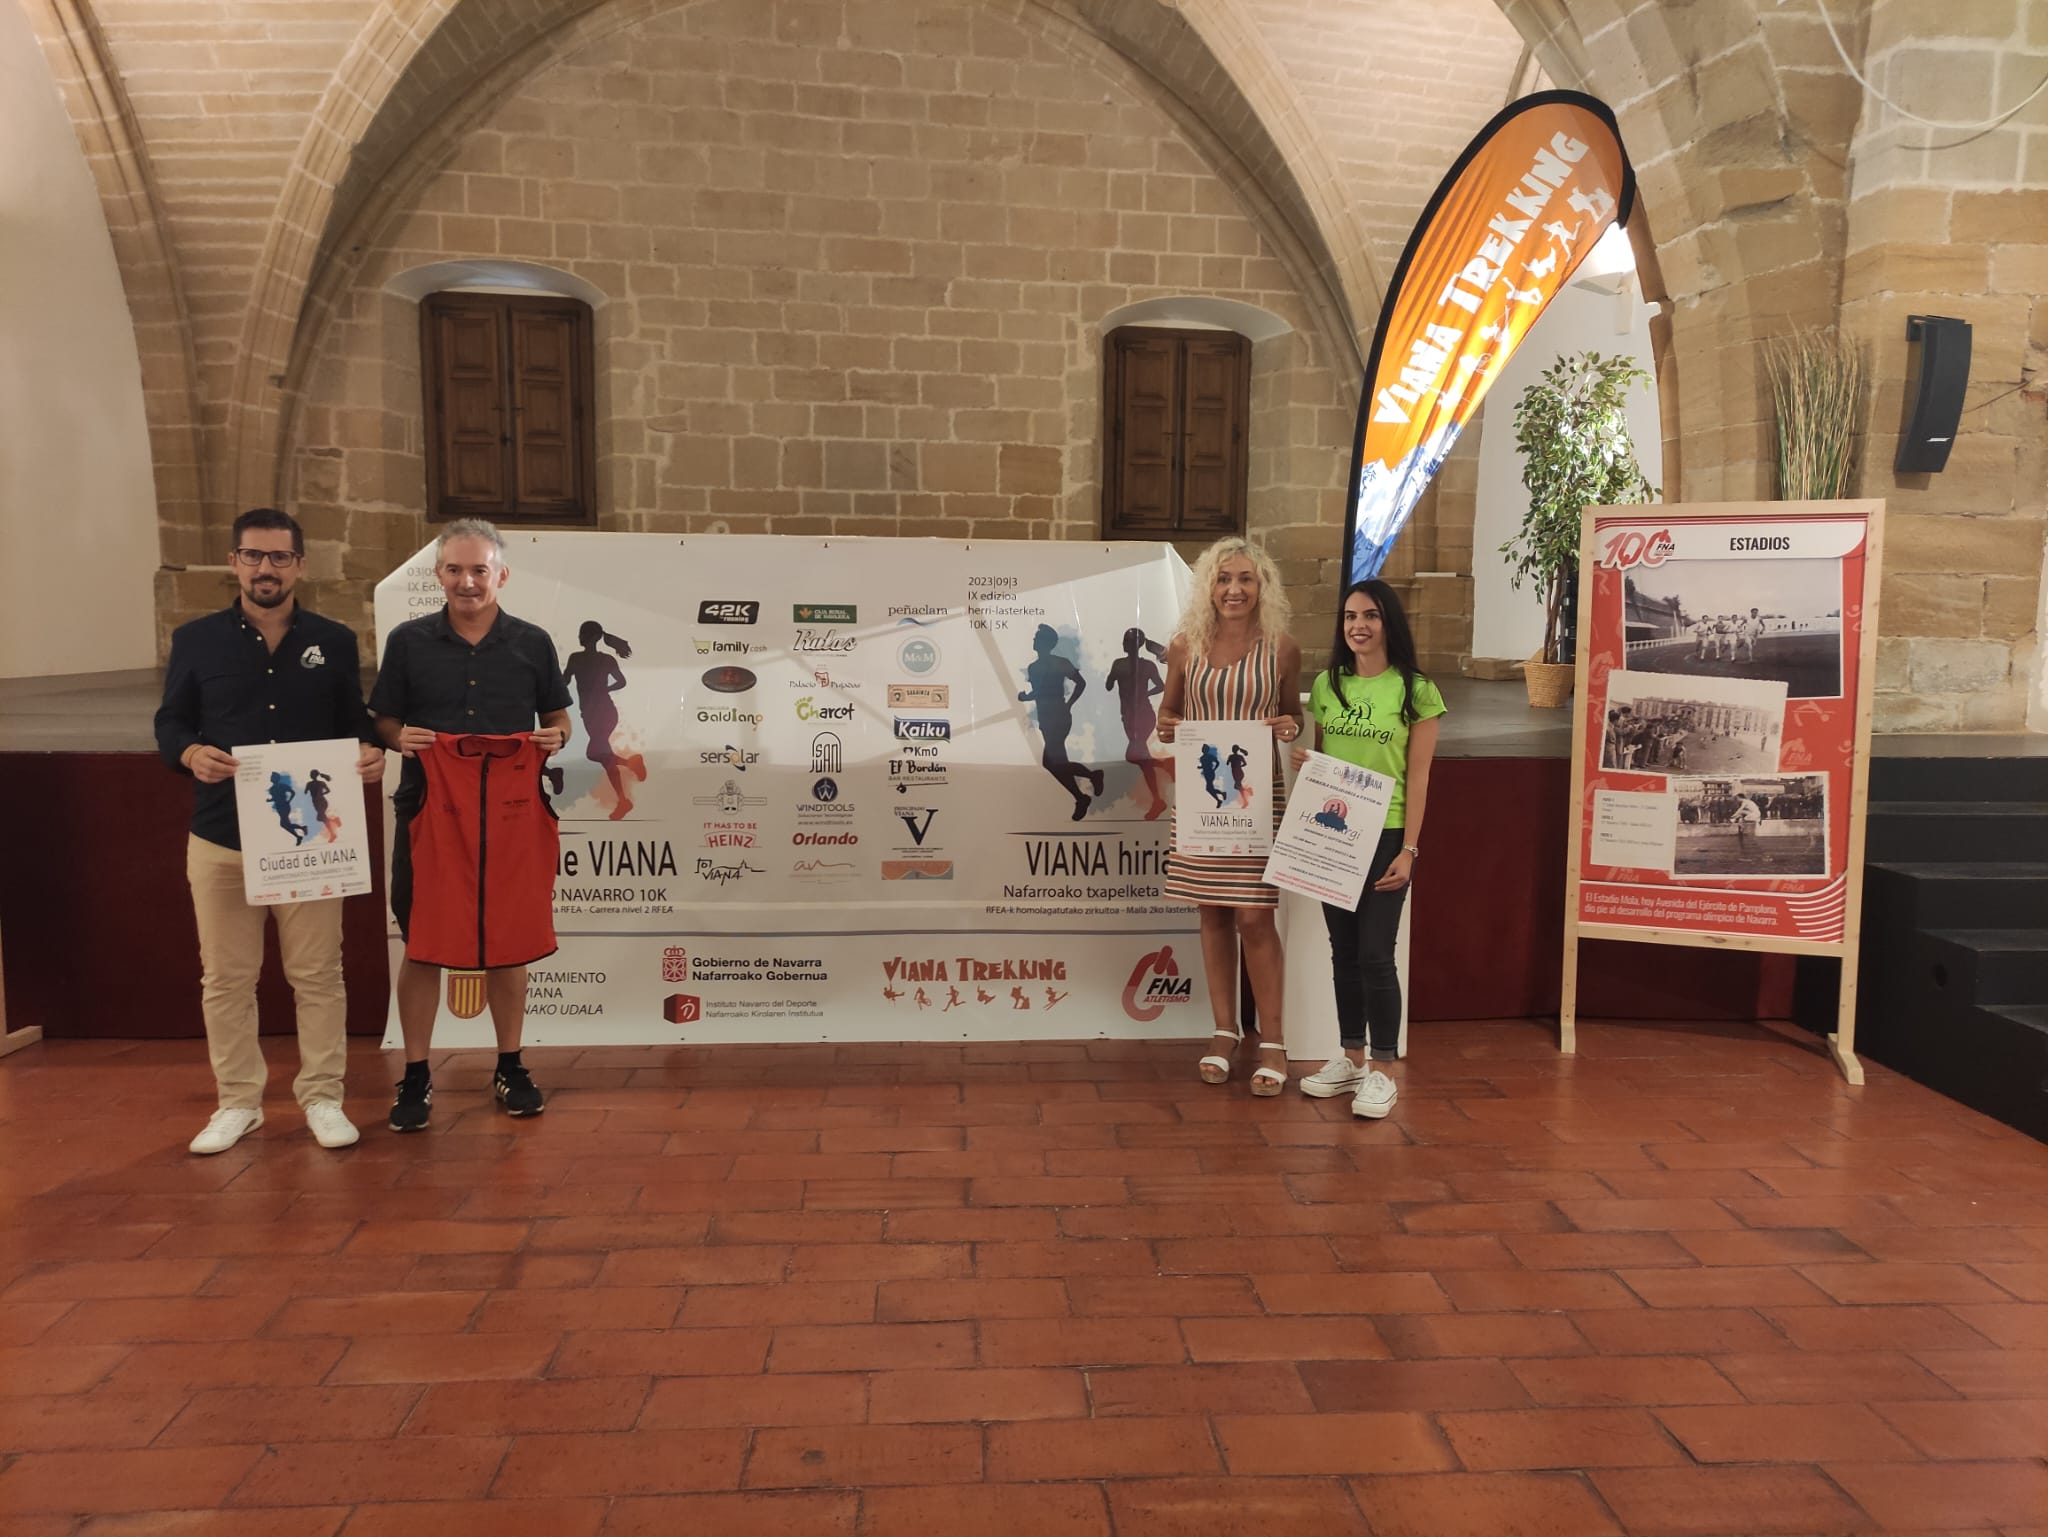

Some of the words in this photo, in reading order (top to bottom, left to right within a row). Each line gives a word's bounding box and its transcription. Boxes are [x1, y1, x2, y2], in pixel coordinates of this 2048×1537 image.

[1373, 322, 1463, 424] VIANA
[1438, 131, 1590, 315] TREKKING
[1656, 543, 1675, 551] FNA
[1730, 537, 1791, 551] ESTADIOS
[407, 582, 420, 592] IX
[968, 591, 978, 601] IX
[980, 591, 1017, 601] edizioa
[704, 604, 752, 617] 42K
[888, 604, 948, 617] peñaclara
[968, 605, 1046, 616] herri-lasterketa
[970, 620, 987, 630] 10K
[995, 620, 1009, 630] 5K
[712, 640, 750, 655] family
[796, 702, 855, 721] Charcot
[898, 722, 946, 739] Kaiku
[888, 760, 903, 775] El
[796, 804, 856, 812] WINDTOOLS
[714, 822, 731, 830] HAS
[733, 822, 745, 830] TO
[1201, 815, 1230, 828] VIANA
[1232, 815, 1254, 828] hiria
[708, 834, 754, 849] HEINZ
[792, 832, 859, 846] Orlando
[259, 854, 300, 872] Ciudad
[303, 854, 318, 867] de
[320, 848, 358, 865] VIANA
[588, 840, 678, 877] VIANA
[1025, 840, 1109, 877] VIANA
[561, 888, 635, 903] NAVARRO
[640, 888, 668, 902] 10K
[1003, 884, 1083, 898] Nafarroako
[1086, 884, 1159, 901] txapelketa
[1585, 892, 1593, 902] El
[1593, 893, 1620, 904] Estadio
[1641, 896, 1655, 908] hoy
[1656, 897, 1685, 908] Avenida
[1686, 899, 1698, 909] del
[1728, 902, 1738, 912] de
[560, 906, 582, 914] RFEA
[589, 906, 620, 914] Carrera
[622, 905, 643, 914] nivel
[644, 906, 650, 914] 2
[651, 906, 674, 914] RFEA
[1126, 905, 1148, 914] Maila
[1149, 905, 1164, 914] 2ko
[1596, 905, 1609, 915] pie
[1609, 905, 1616, 915] al
[1617, 907, 1653, 917] desarrollo
[1653, 908, 1665, 918] del
[1666, 910, 1702, 921] programa
[1736, 914, 1746, 923] de
[692, 957, 750, 968] Gobierno
[754, 957, 770, 968] de
[773, 957, 823, 968] Navarra
[883, 956, 948, 982] VIANA
[955, 957, 1067, 982] TREKKING
[692, 970, 763, 981] Nafarroako
[766, 970, 828, 981] Gobernua
[1147, 977, 1192, 995] FNA
[560, 1003, 603, 1016] UDALA
[706, 1000, 737, 1008] Instituto
[739, 1000, 770, 1008] Navarro
[771, 1000, 784, 1008] del
[786, 1000, 818, 1009] Deporte
[706, 1010, 749, 1018] Nafarroako
[751, 1010, 786, 1018] Kirolaren
[788, 1010, 824, 1018] Institutua
